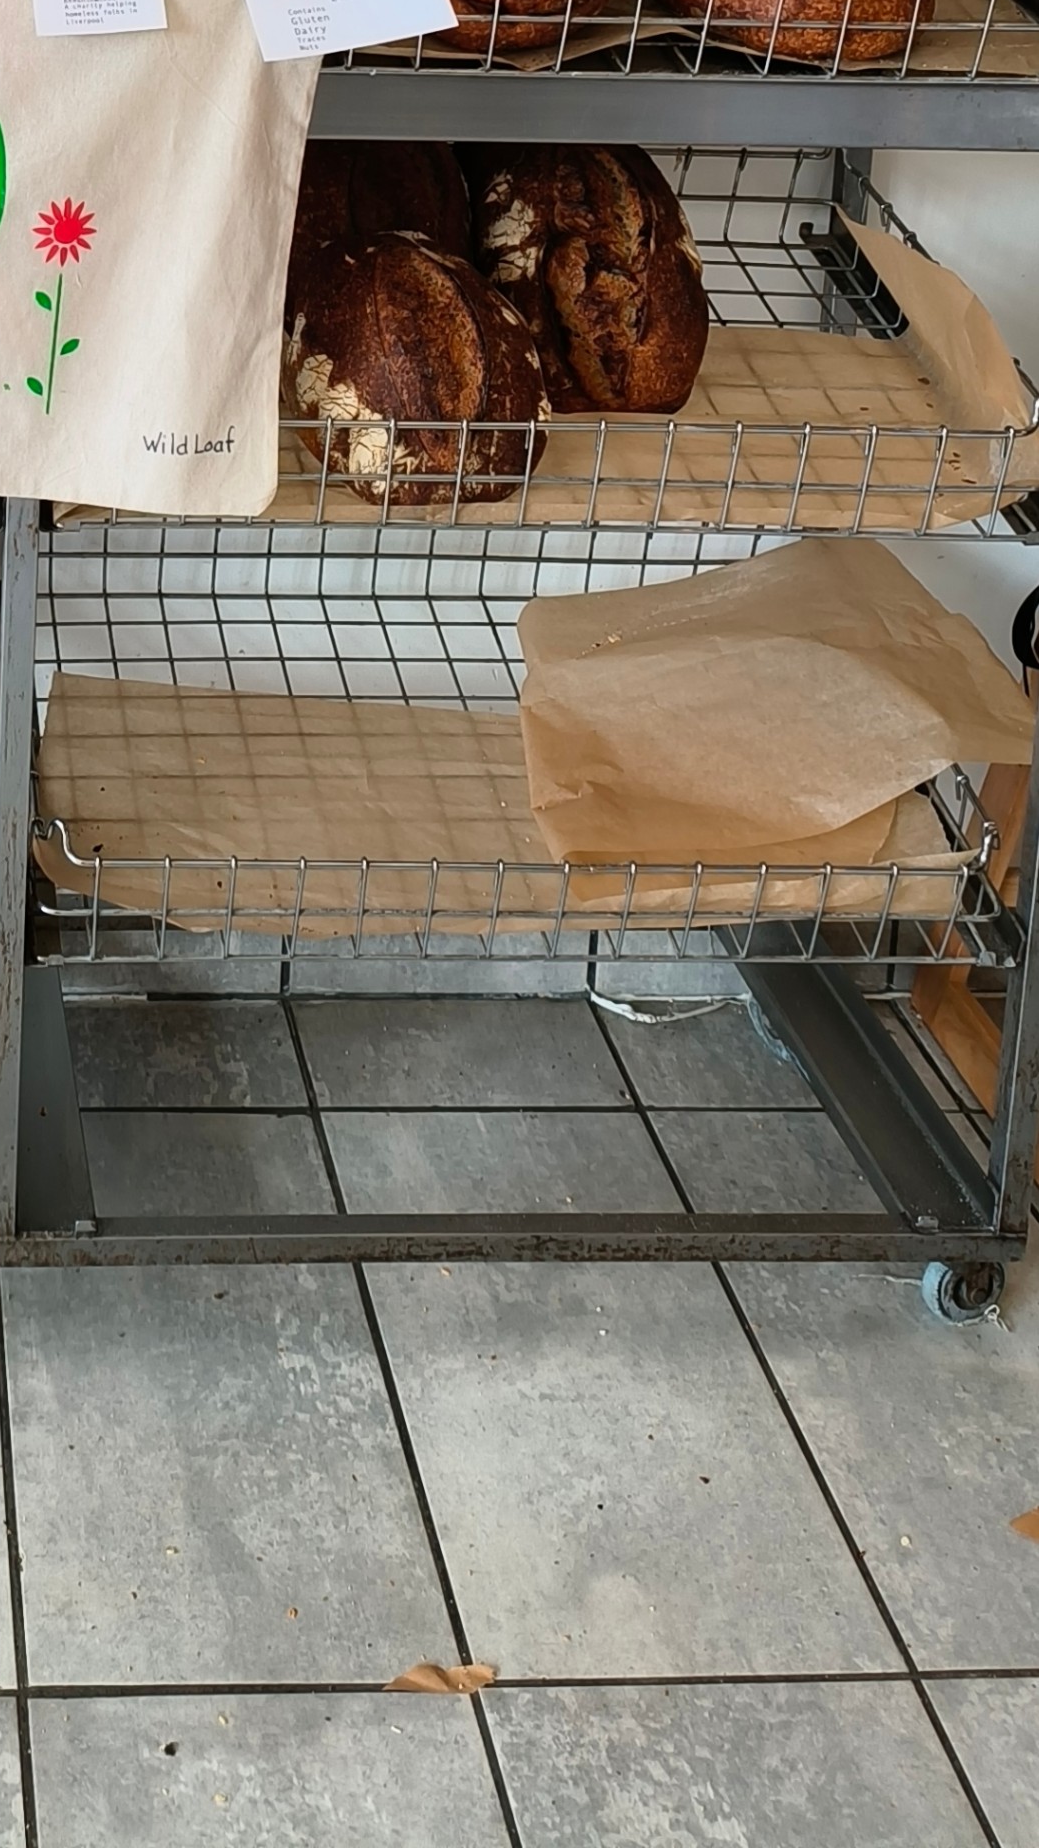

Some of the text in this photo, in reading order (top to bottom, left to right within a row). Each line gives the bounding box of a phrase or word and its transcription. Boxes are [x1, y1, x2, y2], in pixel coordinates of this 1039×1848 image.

[288, 6, 326, 16] Contains
[291, 14, 330, 26] Gluten
[294, 25, 326, 36] Dairy
[297, 35, 326, 44] Traces
[143, 425, 235, 455] Wild Loaf
